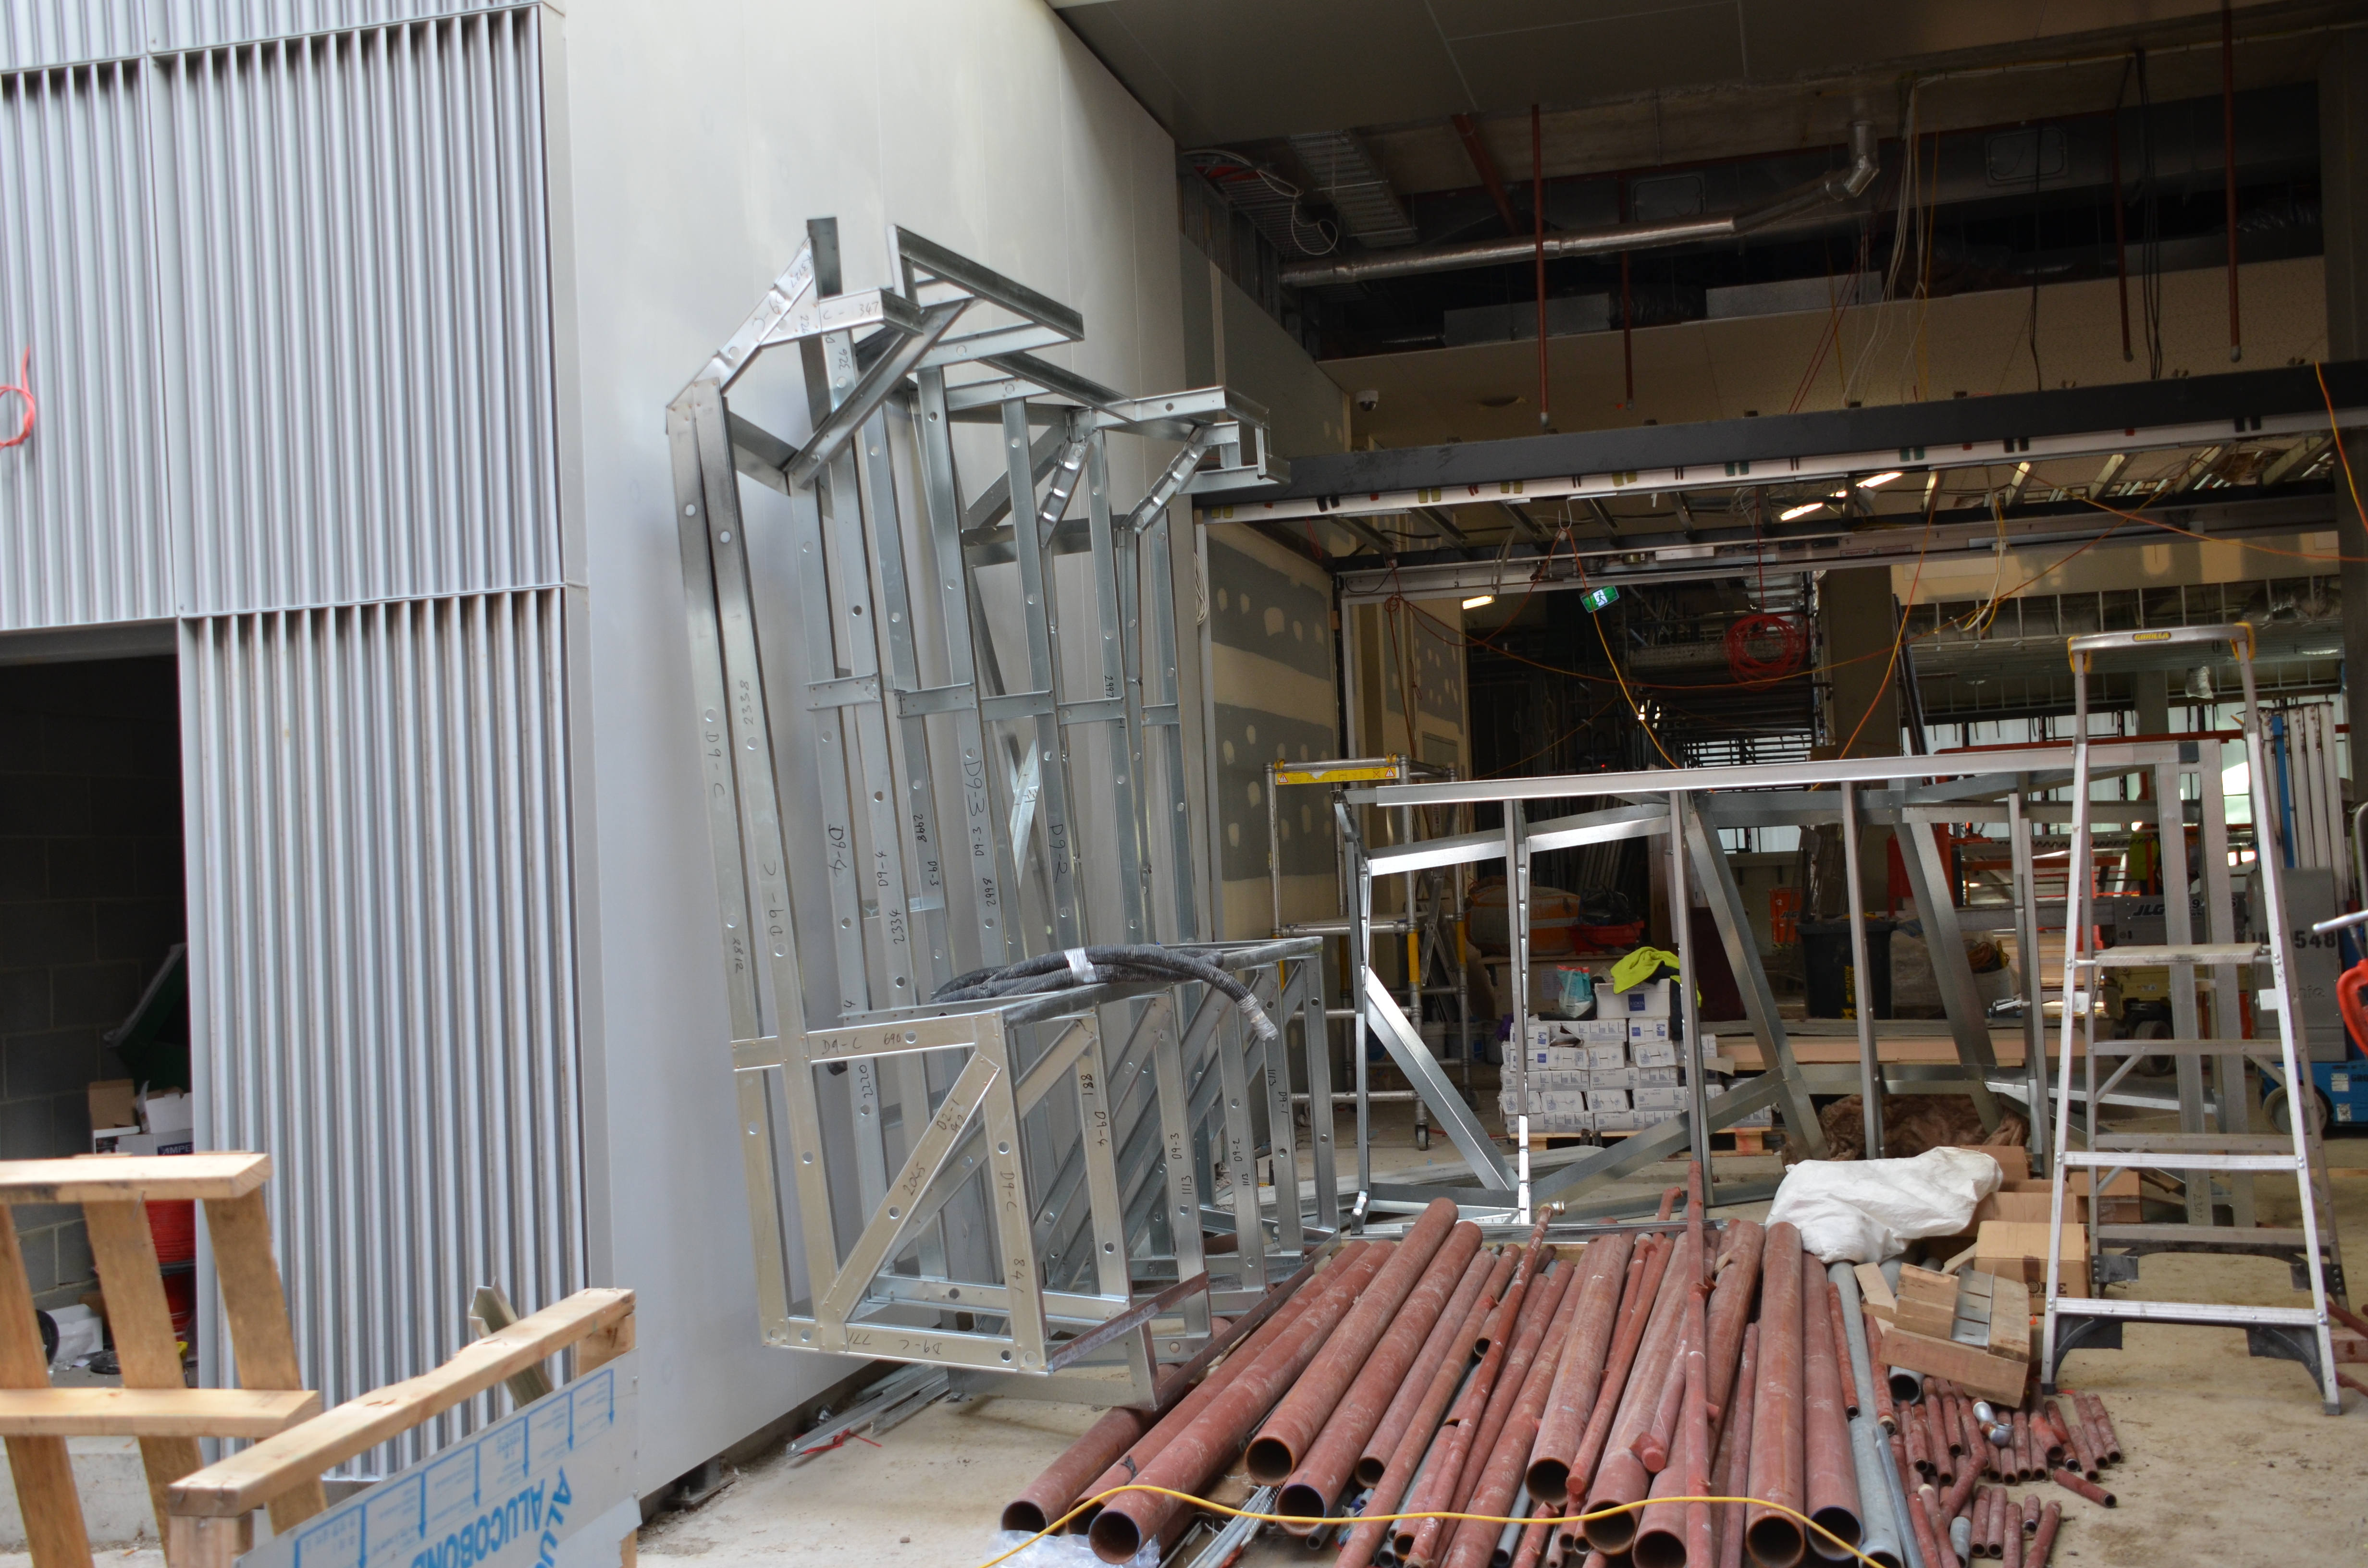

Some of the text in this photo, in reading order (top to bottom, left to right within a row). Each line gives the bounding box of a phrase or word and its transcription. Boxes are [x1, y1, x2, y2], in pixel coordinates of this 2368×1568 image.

[859, 301, 879, 318] 347
[800, 315, 811, 334] 226
[2134, 632, 2169, 640] GORILLA
[1104, 675, 1115, 698] 2997
[739, 680, 754, 725] 2338
[964, 760, 986, 817] D9-3
[913, 814, 928, 843] 2998
[972, 826, 985, 857] D9-3
[828, 825, 847, 877] D9-4
[1049, 823, 1068, 883] D9-2
[875, 850, 889, 887] D9-4
[927, 859, 939, 887] D9-3
[982, 877, 997, 907] 2998
[2132, 904, 2165, 916] JLG
[888, 908, 905, 944] 2334
[1277, 1091, 1289, 1114] D9-1
[1095, 1111, 1108, 1148] D9-4
[1171, 1132, 1183, 1160] D9-3
[1233, 1137, 1244, 1162] D9-2
